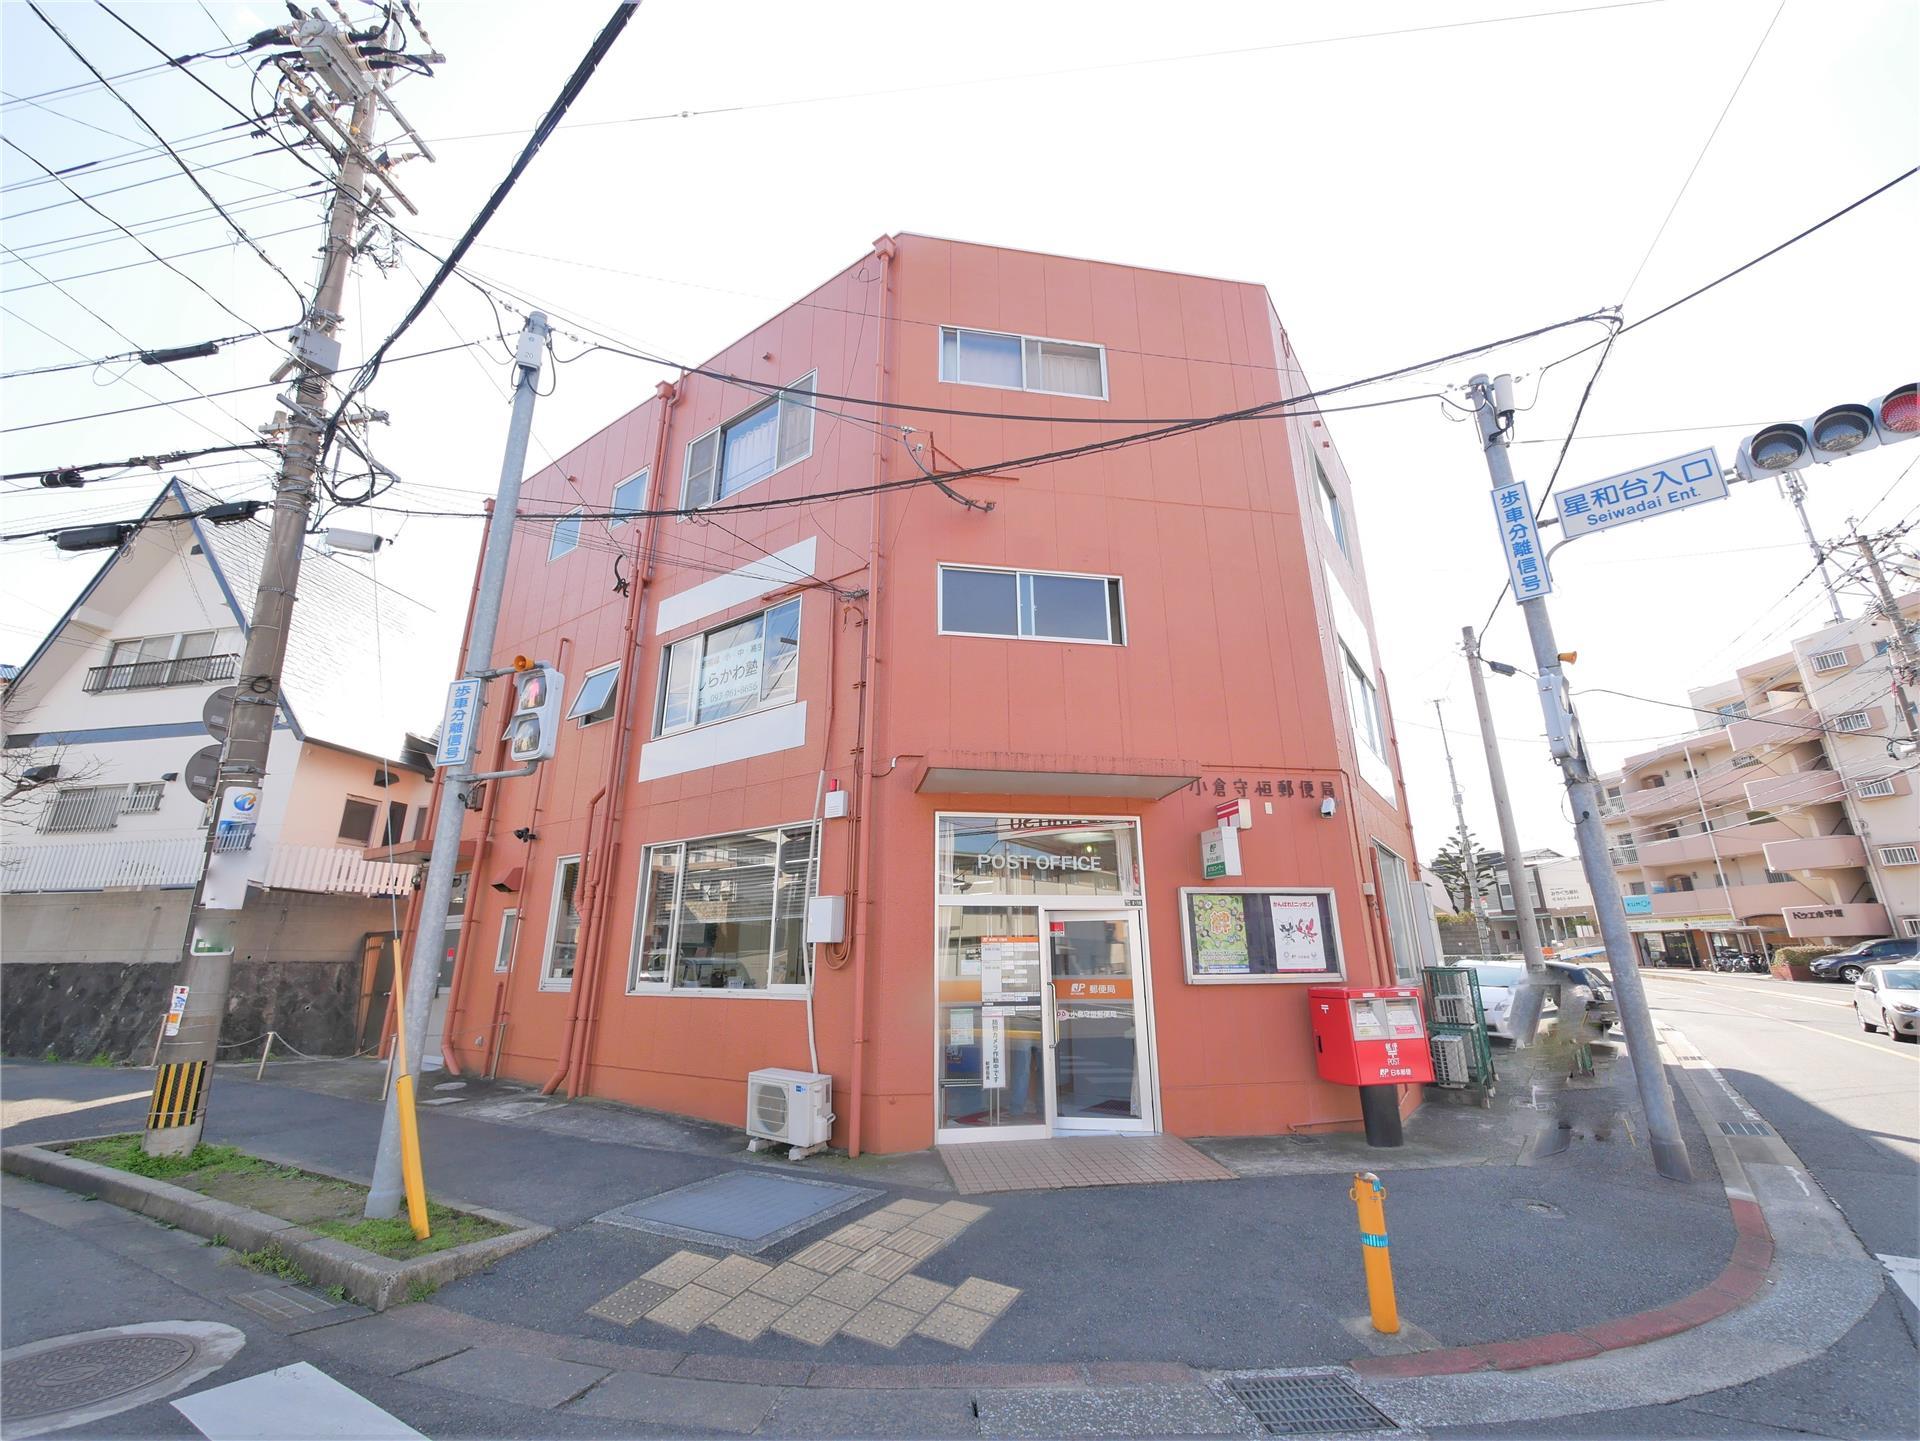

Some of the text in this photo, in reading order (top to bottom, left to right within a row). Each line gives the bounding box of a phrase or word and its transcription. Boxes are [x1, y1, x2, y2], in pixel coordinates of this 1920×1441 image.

[1564, 458, 1713, 517] 星和台入口
[1587, 486, 1701, 526] Seiwadai Ent.
[1500, 490, 1540, 593] 歩車分離信号
[445, 685, 472, 759] 歩車分離信号
[1189, 777, 1335, 799] 小倉守恒郵便局
[977, 855, 1102, 872] POST OFFICE
